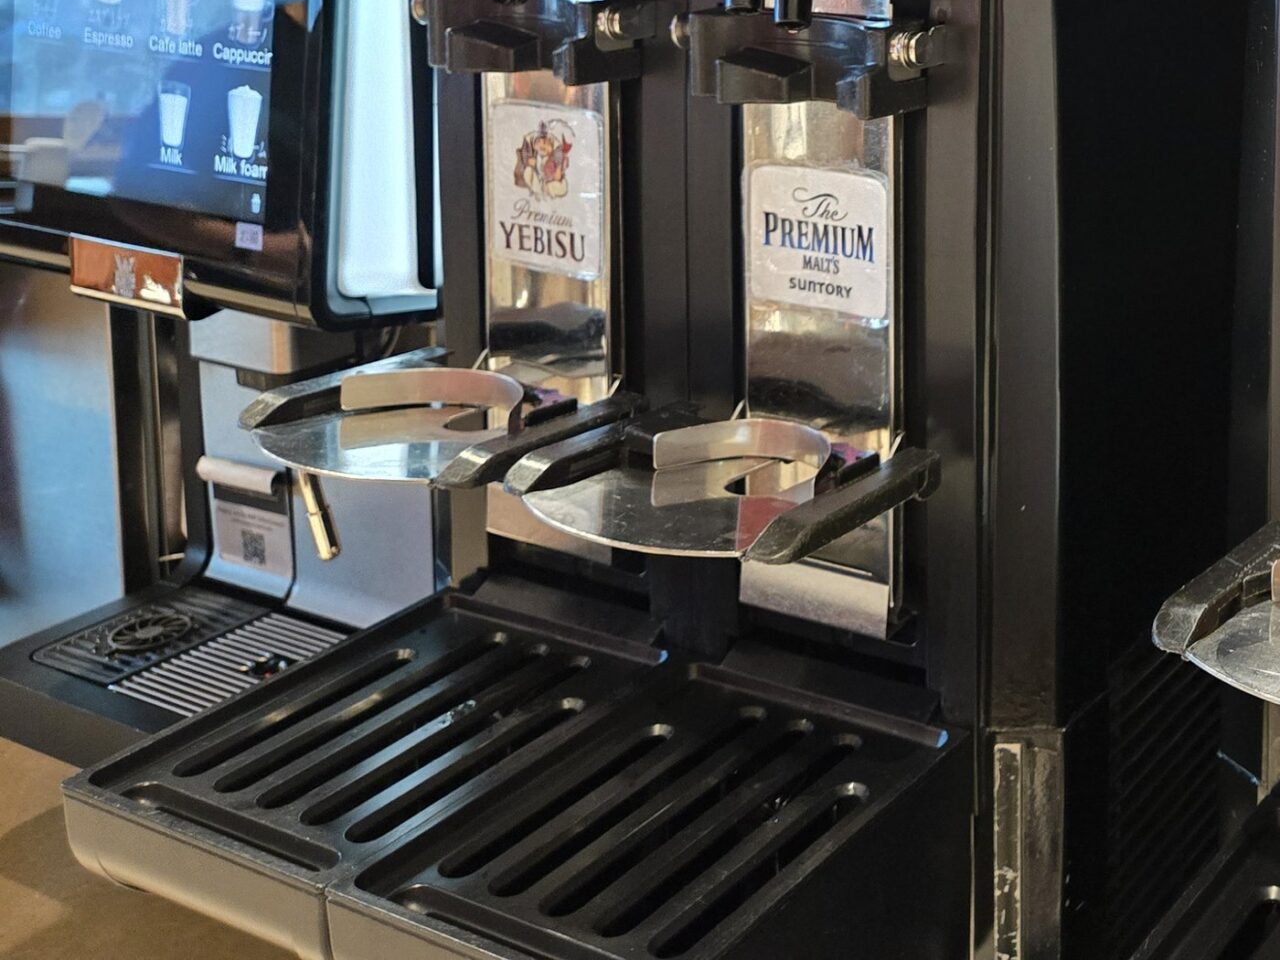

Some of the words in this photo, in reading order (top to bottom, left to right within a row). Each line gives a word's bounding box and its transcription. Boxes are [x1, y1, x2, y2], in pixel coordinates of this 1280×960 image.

[27, 20, 62, 40] Coffee
[84, 29, 134, 50] Espresso
[178, 37, 203, 57] latte
[160, 146, 182, 166] Milk
[214, 153, 237, 175] Milk
[511, 197, 574, 228] Premium
[792, 186, 848, 222] The
[500, 220, 586, 263] YEBISU
[762, 211, 876, 264] PREMIUM
[802, 255, 840, 275] MALT'S
[788, 277, 853, 299] SUNTORY
